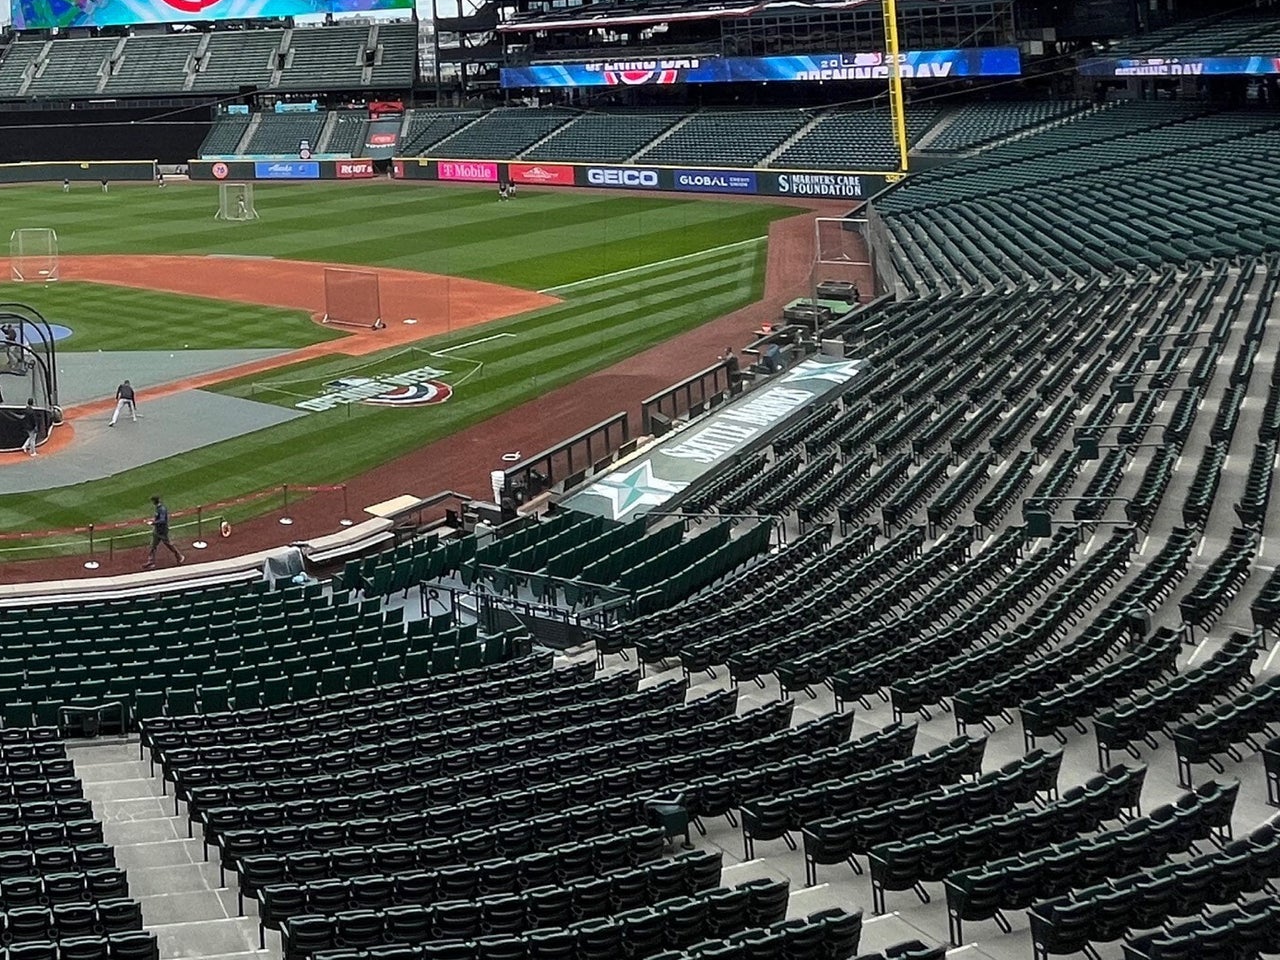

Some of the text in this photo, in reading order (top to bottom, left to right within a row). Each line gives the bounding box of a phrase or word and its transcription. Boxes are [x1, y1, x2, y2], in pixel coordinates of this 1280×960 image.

[341, 165, 366, 174] ROOT
[587, 168, 658, 186] GEICO
[680, 174, 728, 187] GLOBAL
[792, 174, 836, 185] MARINERS
[837, 176, 861, 186] CARE
[793, 183, 862, 197] FOUNDATION
[659, 386, 815, 463] SEATTLE MARINERS
